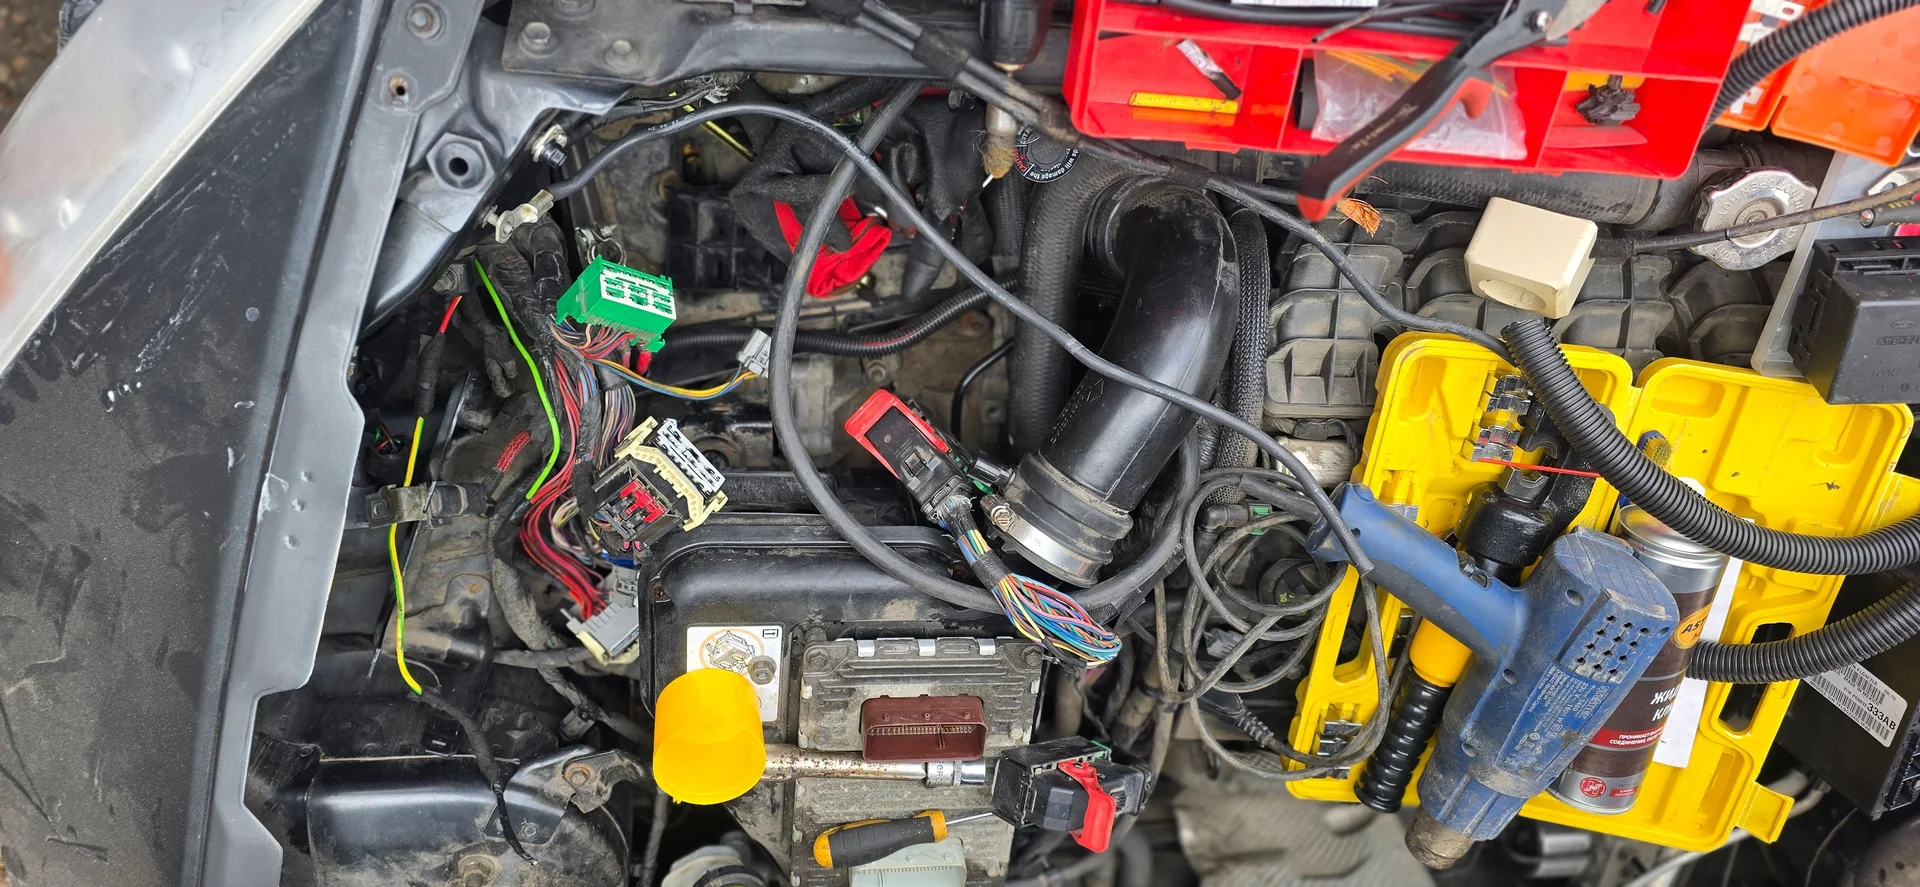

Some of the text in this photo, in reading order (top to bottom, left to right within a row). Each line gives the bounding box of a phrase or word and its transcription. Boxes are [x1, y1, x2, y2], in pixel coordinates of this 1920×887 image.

[1065, 158, 1074, 169] will
[1042, 167, 1065, 179] damage
[1741, 179, 1775, 194] OPEN
[1719, 194, 1738, 216] HOT
